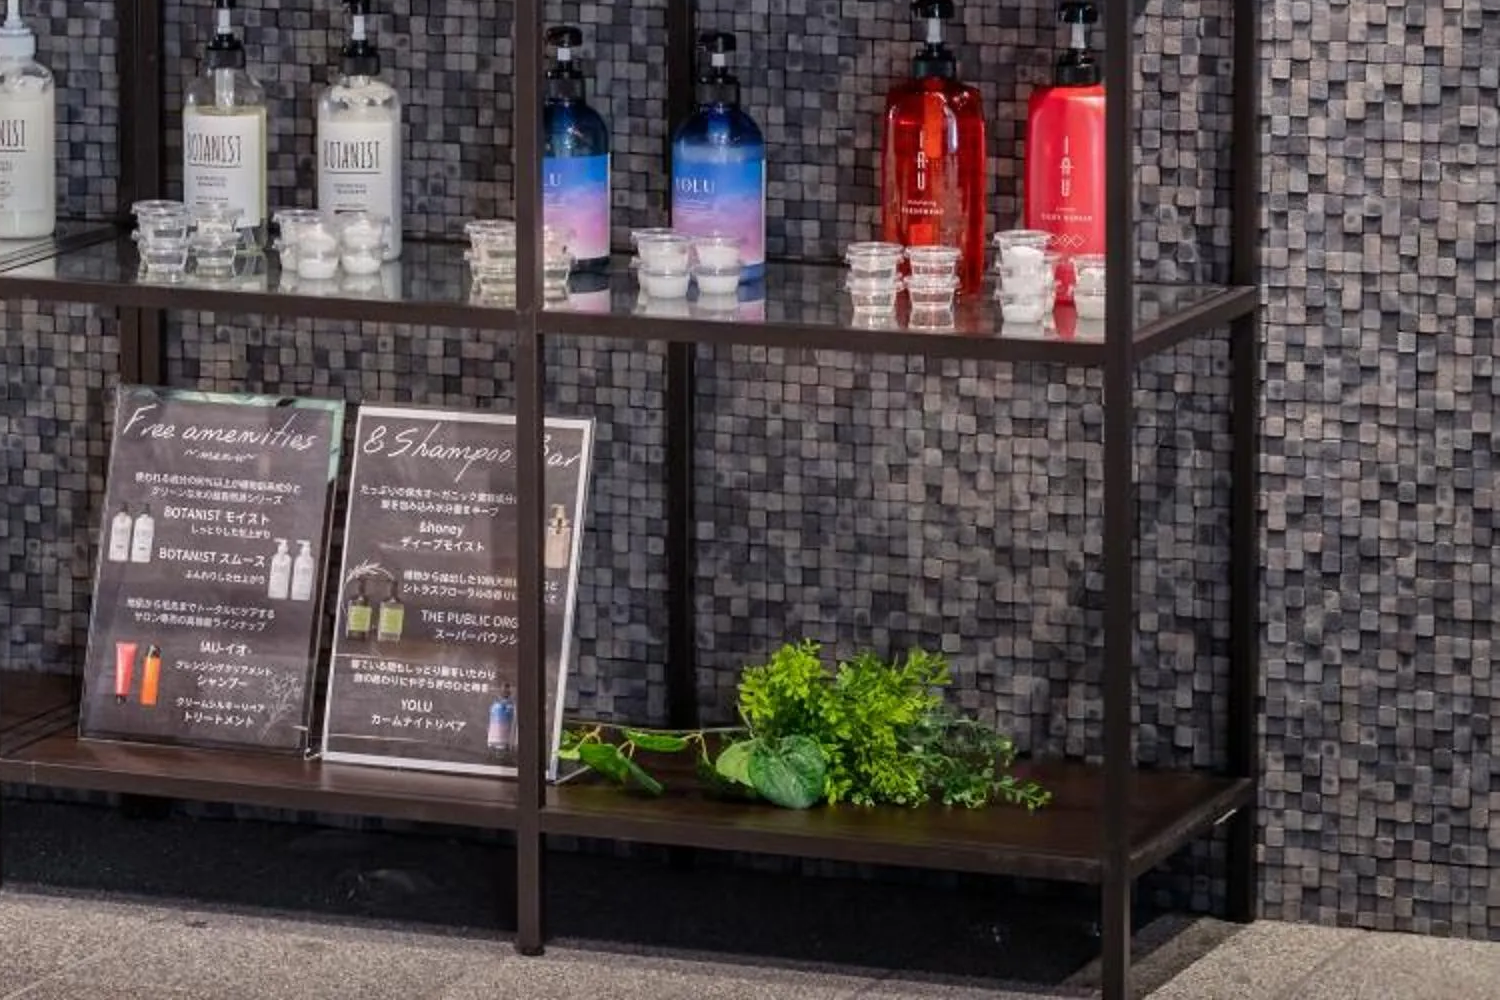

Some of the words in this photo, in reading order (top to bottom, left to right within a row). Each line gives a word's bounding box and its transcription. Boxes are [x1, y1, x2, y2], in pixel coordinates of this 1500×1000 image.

[123, 403, 176, 439] Free
[181, 411, 318, 451] amenities
[388, 422, 512, 484] Shampoo
[163, 505, 221, 521] BOTANIST
[225, 510, 271, 526] モイスト
[419, 520, 465, 537] &honey
[159, 547, 217, 563] BOTANIST
[219, 552, 266, 568] スムース
[420, 609, 445, 623] THE
[447, 611, 492, 627] PUBLIC
[197, 674, 248, 690] シャンプー
[401, 699, 433, 713] YOLU
[184, 711, 254, 728] トリートメント
